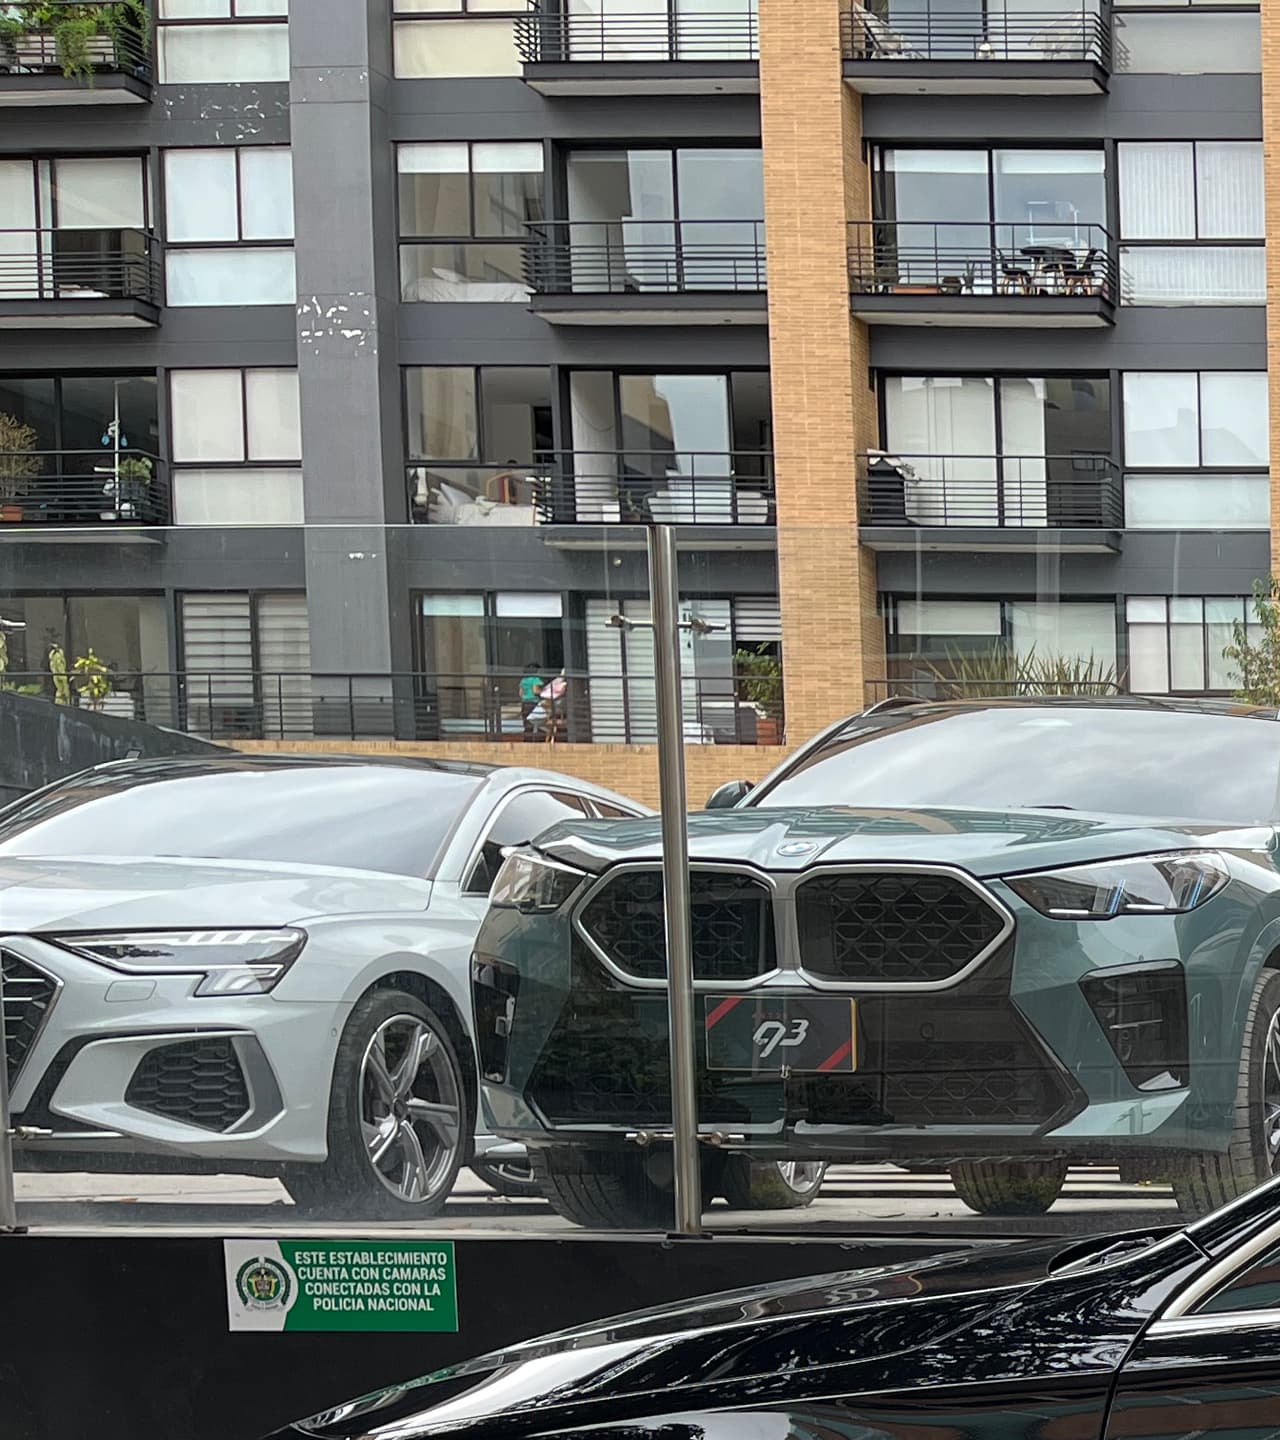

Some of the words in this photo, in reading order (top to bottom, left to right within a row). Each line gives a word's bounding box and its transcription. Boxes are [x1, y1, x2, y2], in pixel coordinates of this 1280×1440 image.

[294, 1251, 326, 1265] ESTE
[329, 1251, 448, 1265] ESTABLECIMIENTO
[298, 1267, 349, 1280] CUENTA
[351, 1267, 379, 1280] CON
[382, 1267, 446, 1281] CAMARAS
[305, 1282, 390, 1296] CONECTADAS
[393, 1282, 420, 1296] CON
[424, 1283, 441, 1296] LA
[313, 1297, 365, 1311] POLICIA
[367, 1298, 434, 1311] NACIONAL
